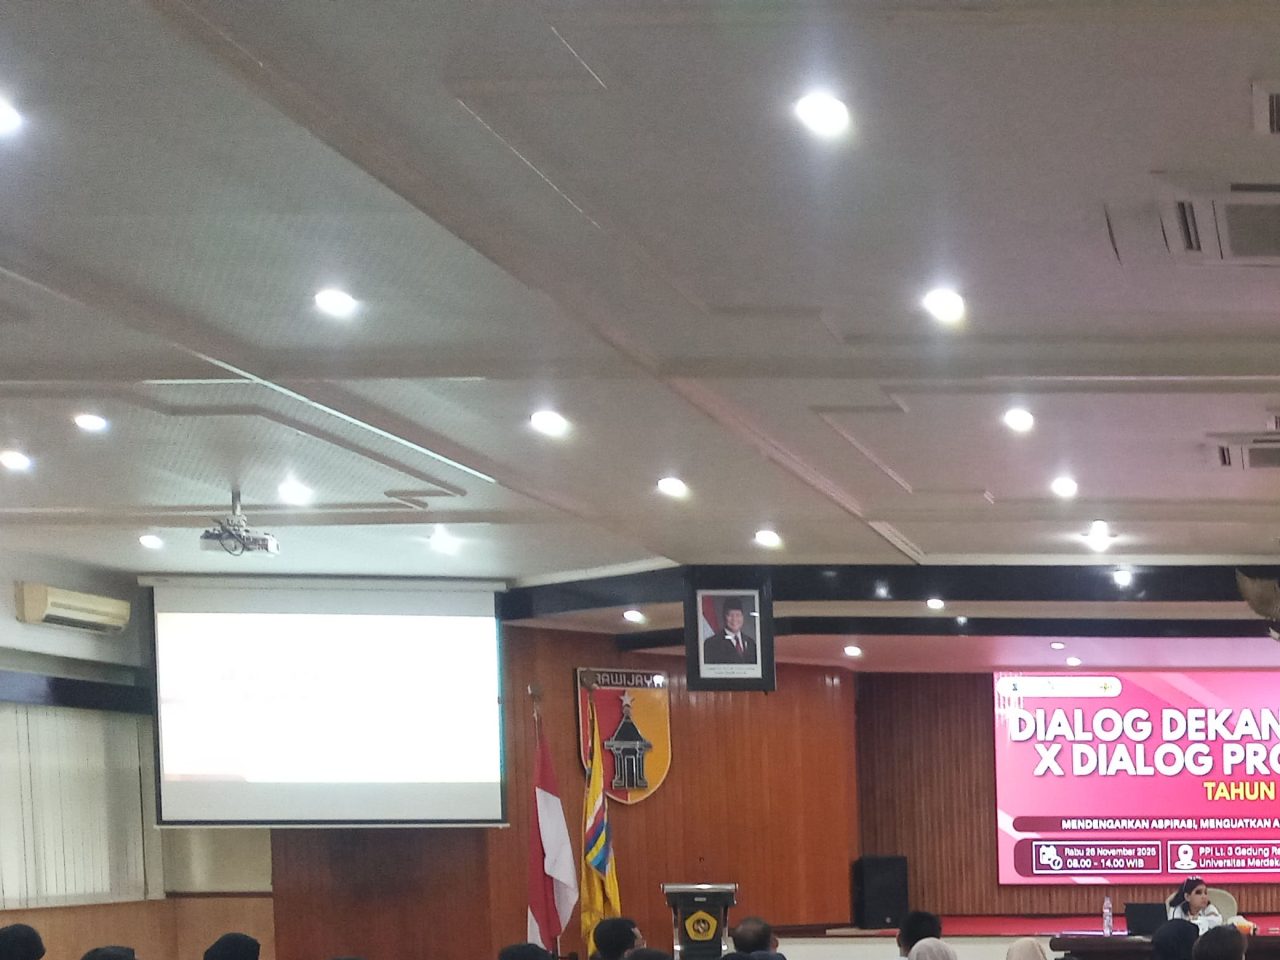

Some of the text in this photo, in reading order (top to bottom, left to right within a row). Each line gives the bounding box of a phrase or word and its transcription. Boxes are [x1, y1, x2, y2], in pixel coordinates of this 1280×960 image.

[1010, 707, 1153, 742] DIALOG
[1033, 743, 1065, 776] X
[1072, 743, 1214, 776] DIALOG
[1203, 781, 1276, 801] TAHUN
[1061, 819, 1150, 830] MENDENGARKAN
[1200, 818, 1272, 829] MENGUATKAN
[1064, 847, 1085, 856] Rabu
[1097, 847, 1136, 856] November
[1235, 846, 1270, 857] Gedung
[1067, 859, 1092, 868] 08.00
[1101, 859, 1124, 868] 14.00
[1126, 858, 1144, 868] WIB
[1199, 858, 1246, 868] Universitas
